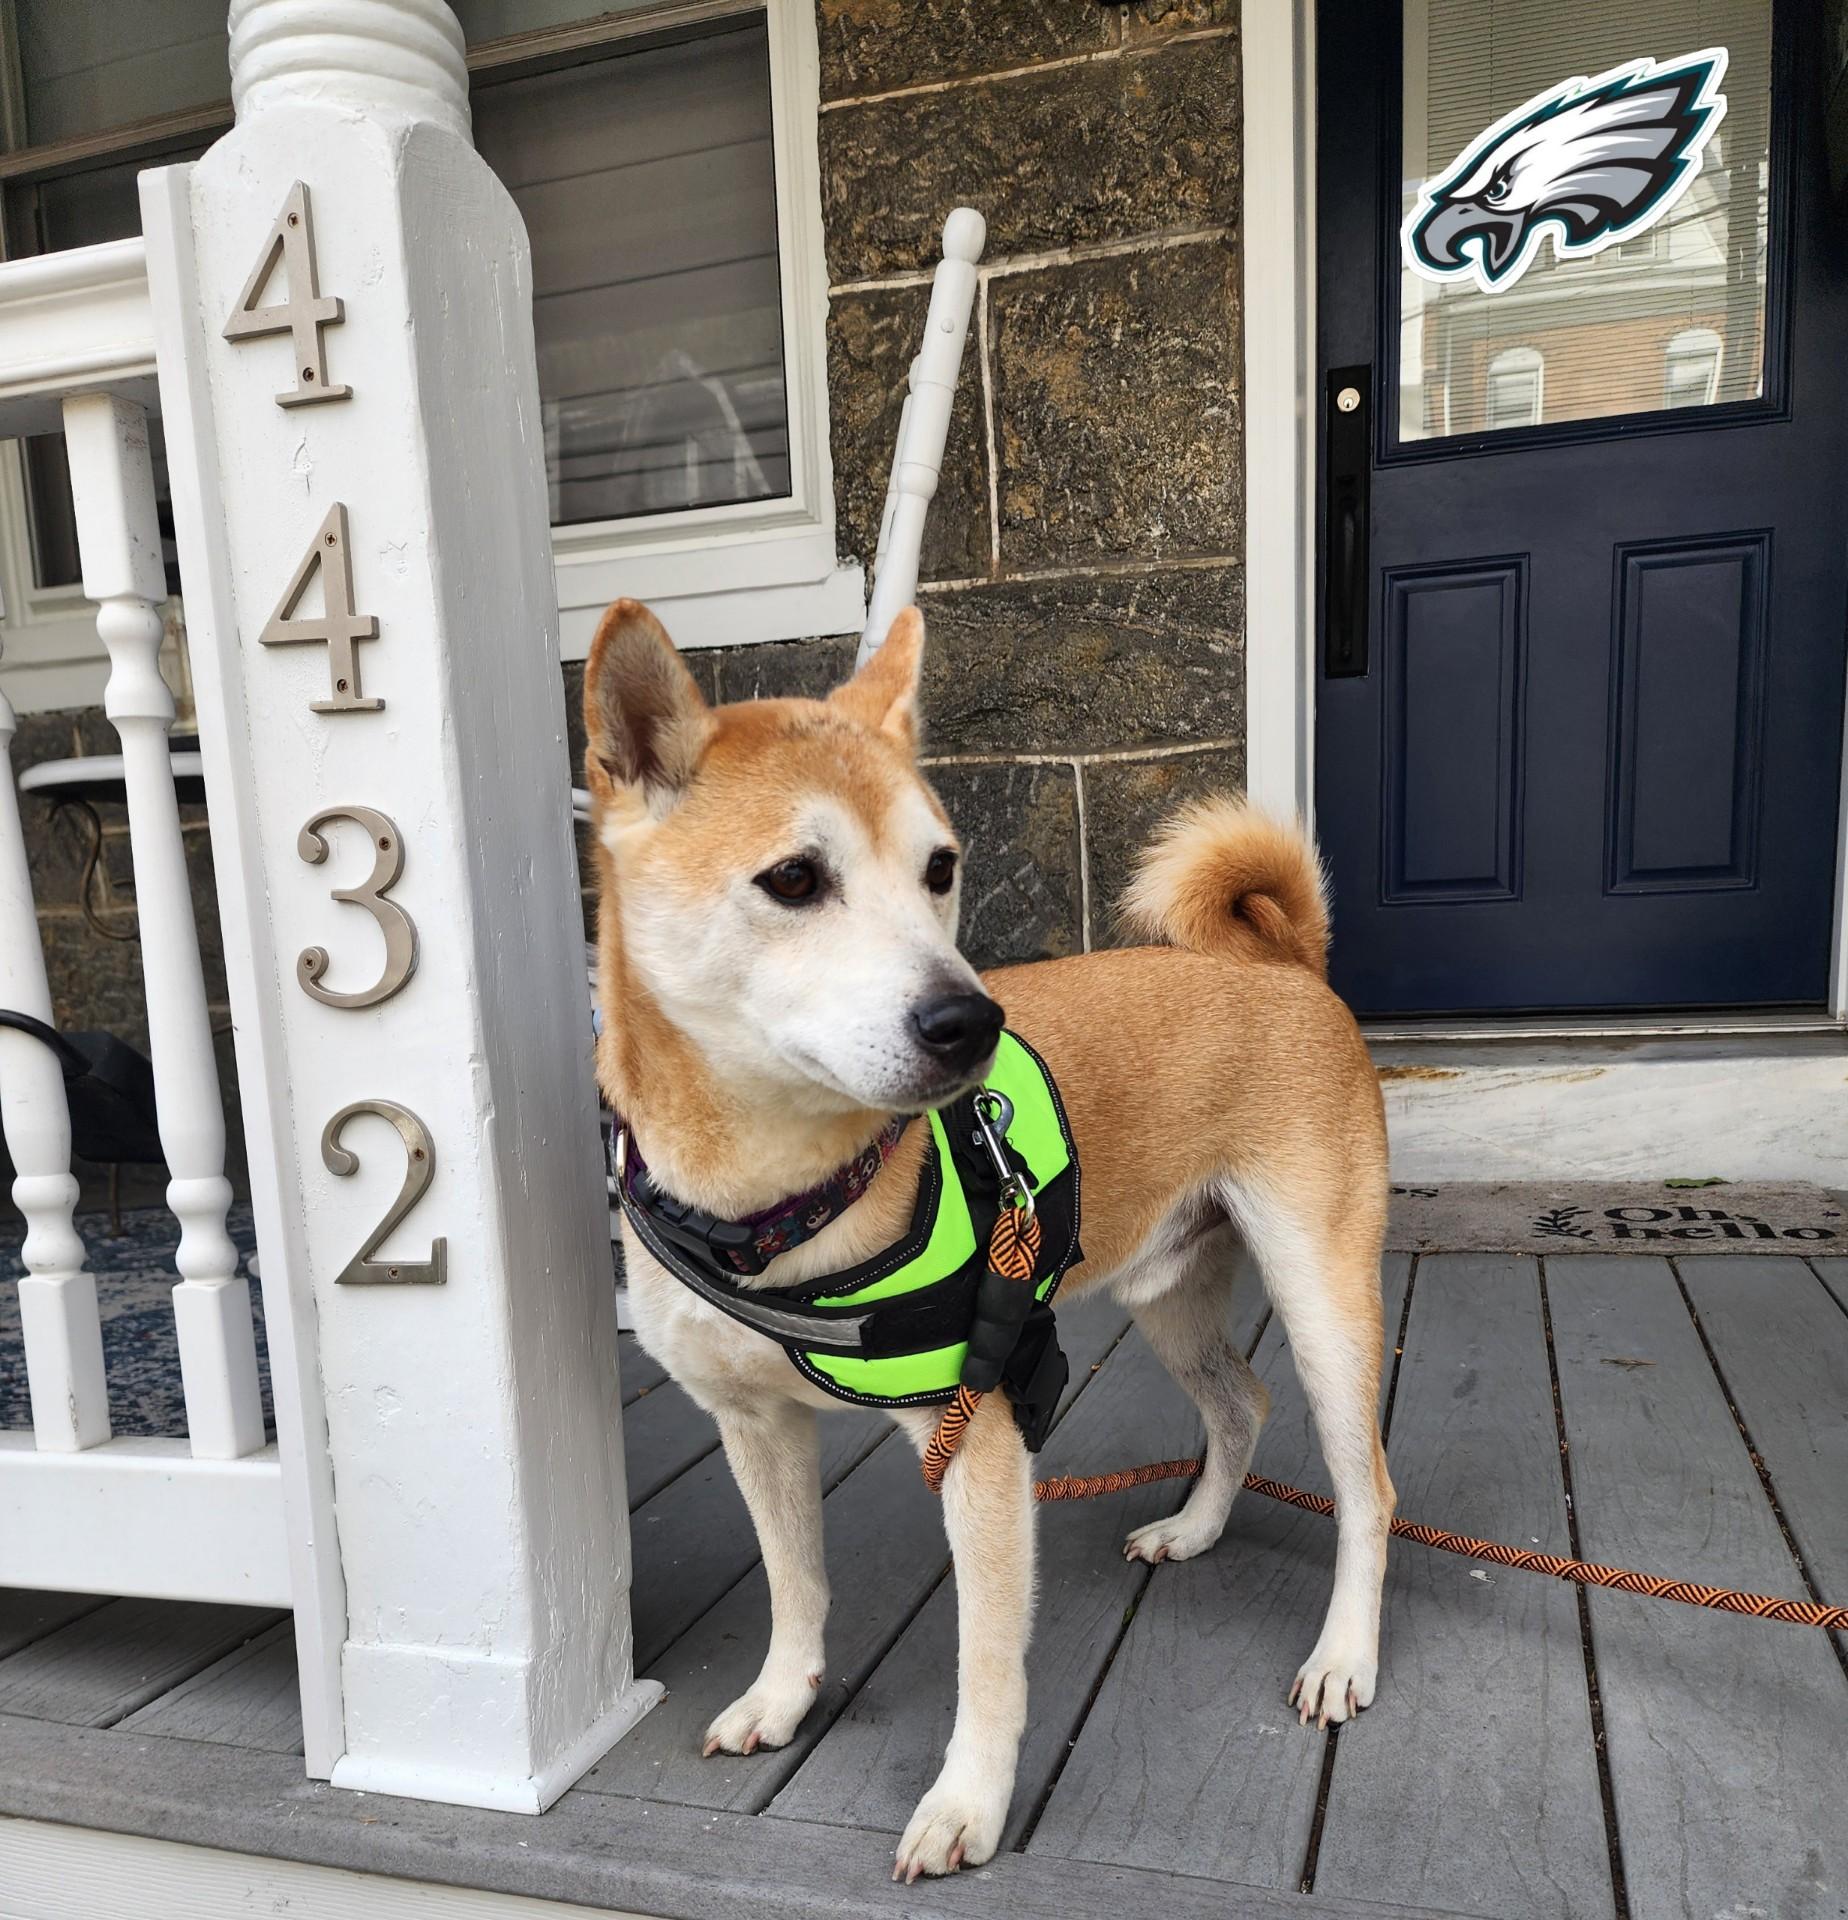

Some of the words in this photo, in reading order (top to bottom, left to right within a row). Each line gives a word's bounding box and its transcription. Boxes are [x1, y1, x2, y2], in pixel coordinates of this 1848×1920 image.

[222, 178, 448, 1286] 4432
[1603, 1206, 1759, 1223] Oh,
[1605, 1222, 1837, 1241] hello
